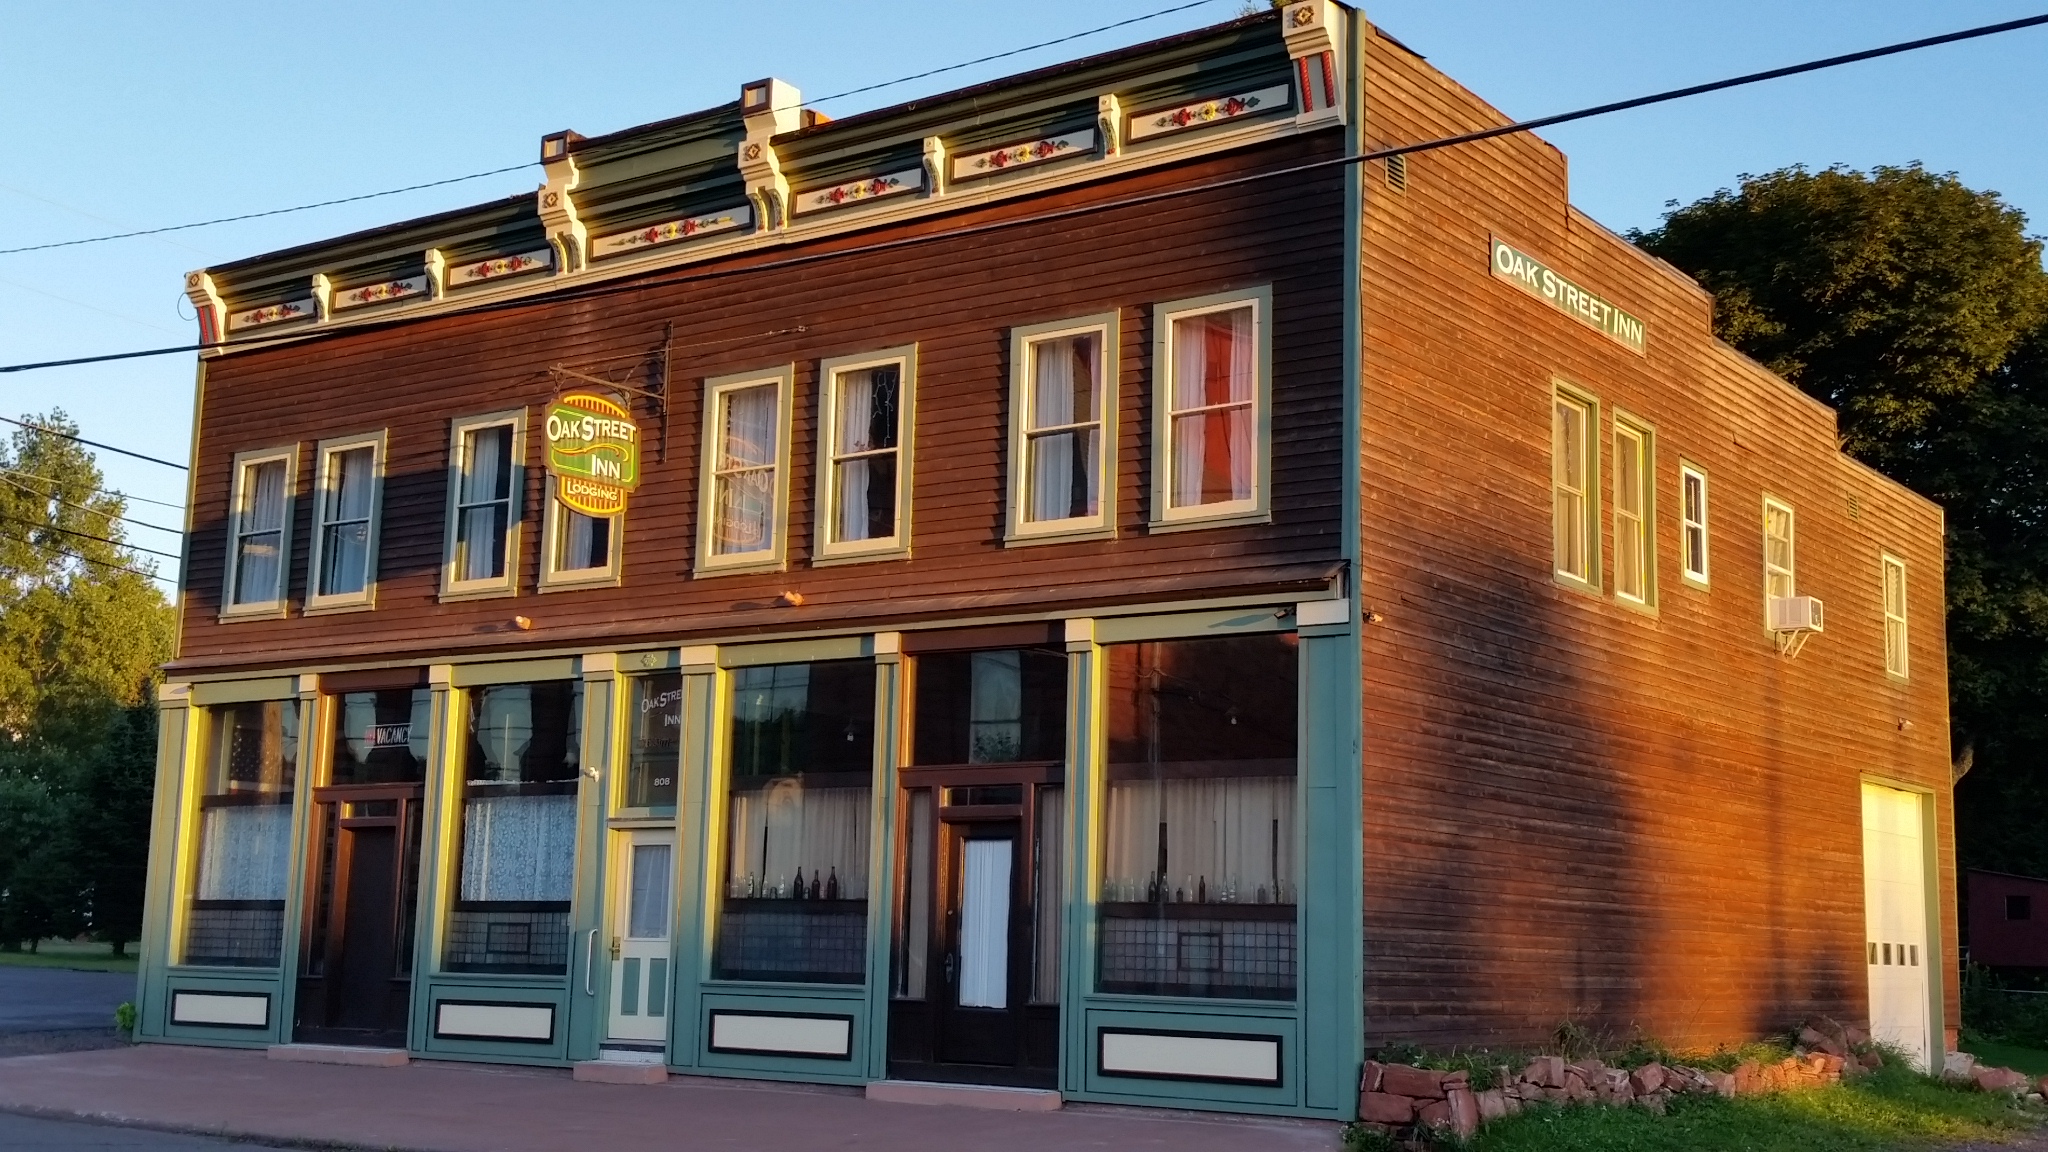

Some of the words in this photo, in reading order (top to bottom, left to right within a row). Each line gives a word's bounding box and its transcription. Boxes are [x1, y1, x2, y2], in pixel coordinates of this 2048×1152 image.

[1496, 244, 1539, 288] OAK
[1542, 269, 1611, 325] STREET
[1613, 308, 1643, 344] INN
[546, 415, 581, 441] OAK
[582, 416, 637, 443] STREET
[591, 454, 621, 479] INN
[567, 481, 618, 501] LODGING
[641, 696, 660, 713] OAK
[660, 689, 682, 708] STRE
[664, 713, 681, 727] INN
[377, 726, 413, 745] VACANCY
[654, 777, 671, 787] 808
